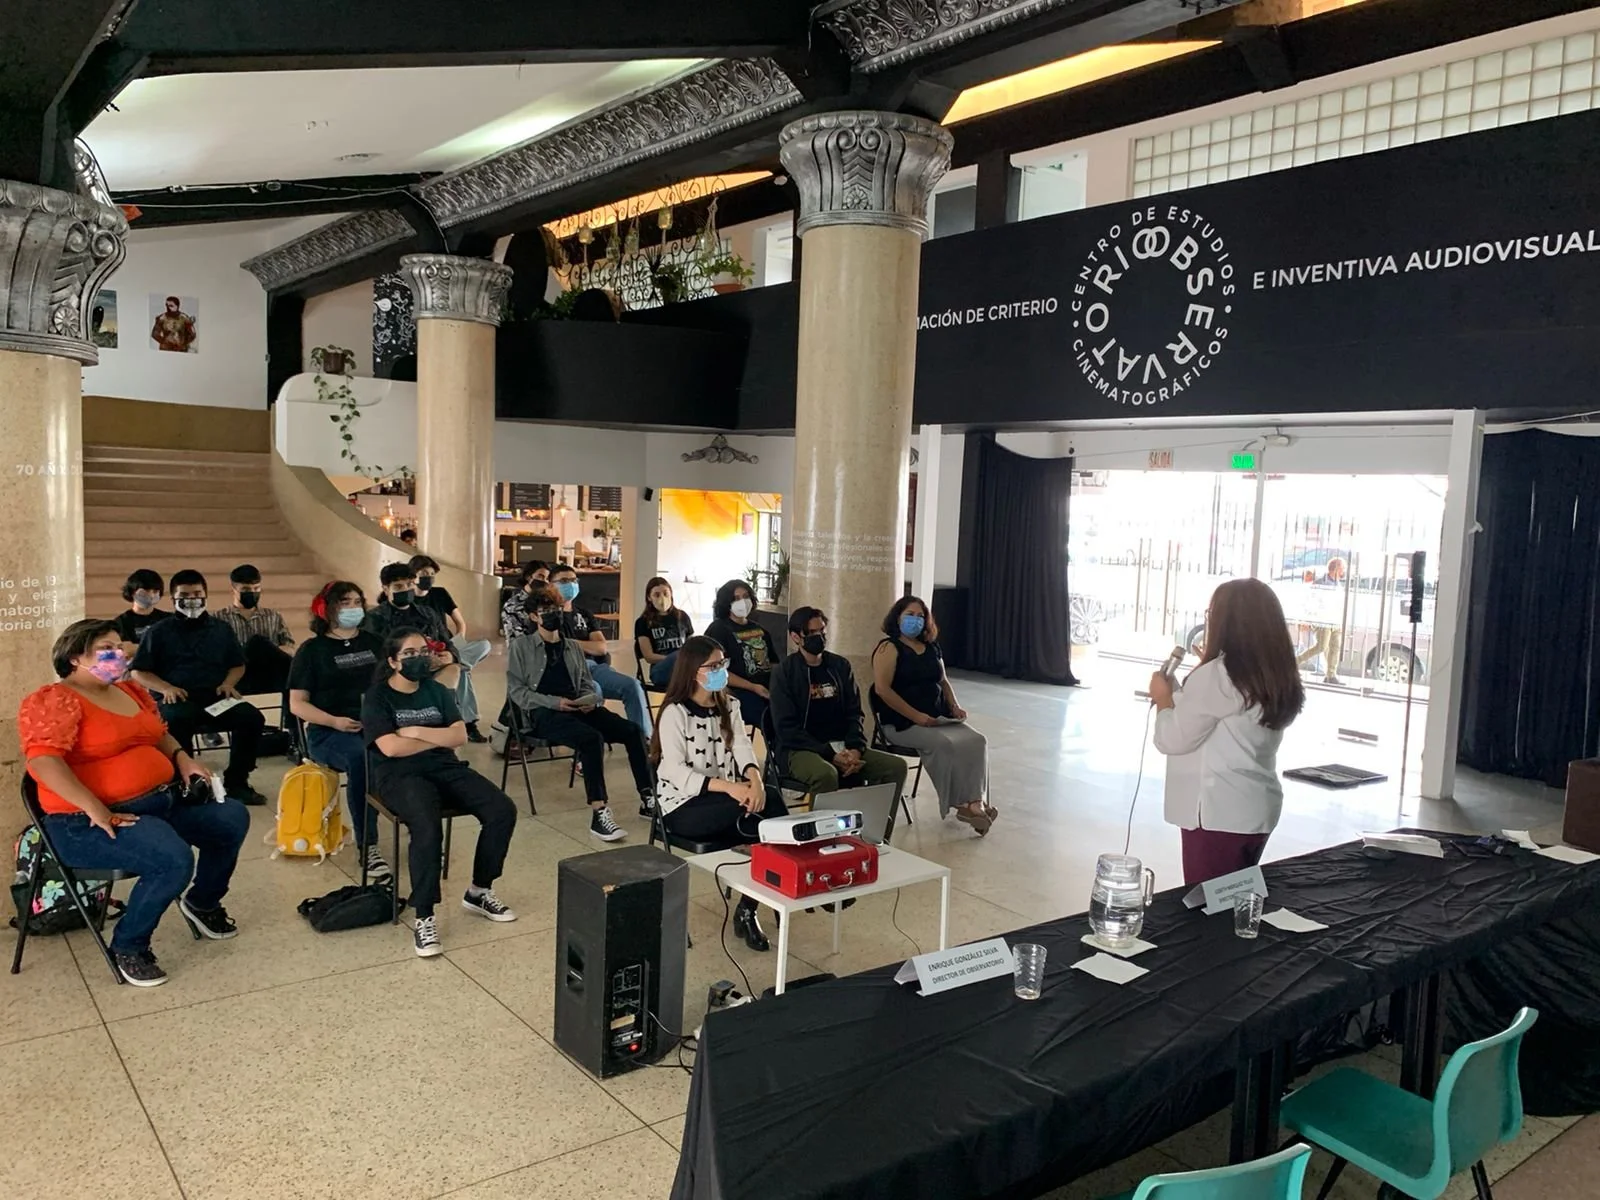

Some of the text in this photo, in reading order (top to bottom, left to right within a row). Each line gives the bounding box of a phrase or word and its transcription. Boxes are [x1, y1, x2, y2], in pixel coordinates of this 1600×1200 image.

[1072, 205, 1236, 312] CENTRO DE ESTUDIOS
[1252, 229, 1600, 290] E INVENTIVA AUDIOVISUAL
[966, 306, 985, 325] DE
[988, 297, 1059, 322] CRITERIO
[1073, 326, 1228, 406] CINEMATOGRÁFICOS
[15, 464, 34, 476] 70
[21, 576, 39, 588] de
[8, 593, 18, 605] y
[928, 946, 999, 972] ENRIQUE GONZÁLEZ SILVA
[932, 958, 1005, 984] DIRECTOR DE OBSERVATORIO
